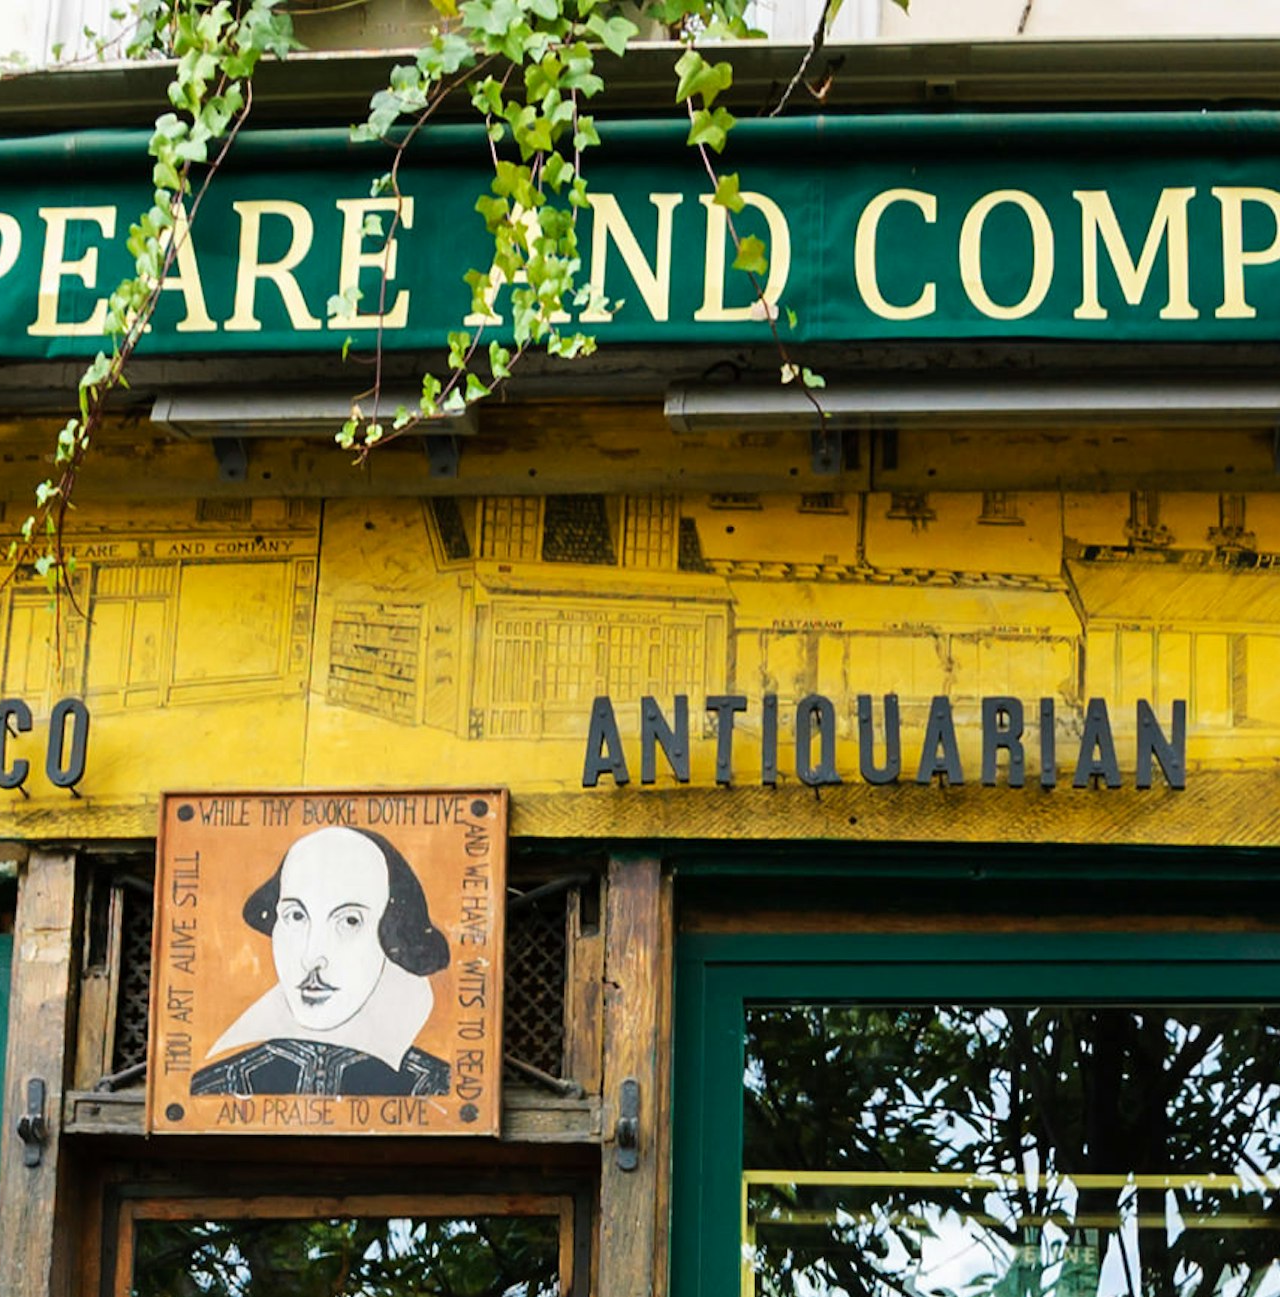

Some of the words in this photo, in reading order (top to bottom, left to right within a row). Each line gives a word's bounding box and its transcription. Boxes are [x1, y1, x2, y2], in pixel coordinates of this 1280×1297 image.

[582, 695, 1187, 788] ANTIQUARIAN
[200, 799, 250, 826] WHILE
[260, 800, 293, 825] THY
[302, 798, 358, 825] BOOKE
[367, 798, 417, 825] DOTH
[424, 796, 468, 825] LIVE
[464, 822, 490, 858] AND
[172, 850, 200, 908] STILL
[463, 862, 489, 890] WE
[460, 896, 487, 946] HAVE
[169, 918, 197, 975] ALIVE
[167, 985, 194, 1024] ART
[459, 958, 486, 1009] WITS
[457, 1020, 485, 1041] TO
[165, 1032, 192, 1076] THOU
[455, 1049, 484, 1101] READ
[217, 1100, 255, 1124] AND
[263, 1099, 334, 1125] PRAISE
[347, 1100, 370, 1125] TO
[381, 1100, 429, 1126] GIVE
